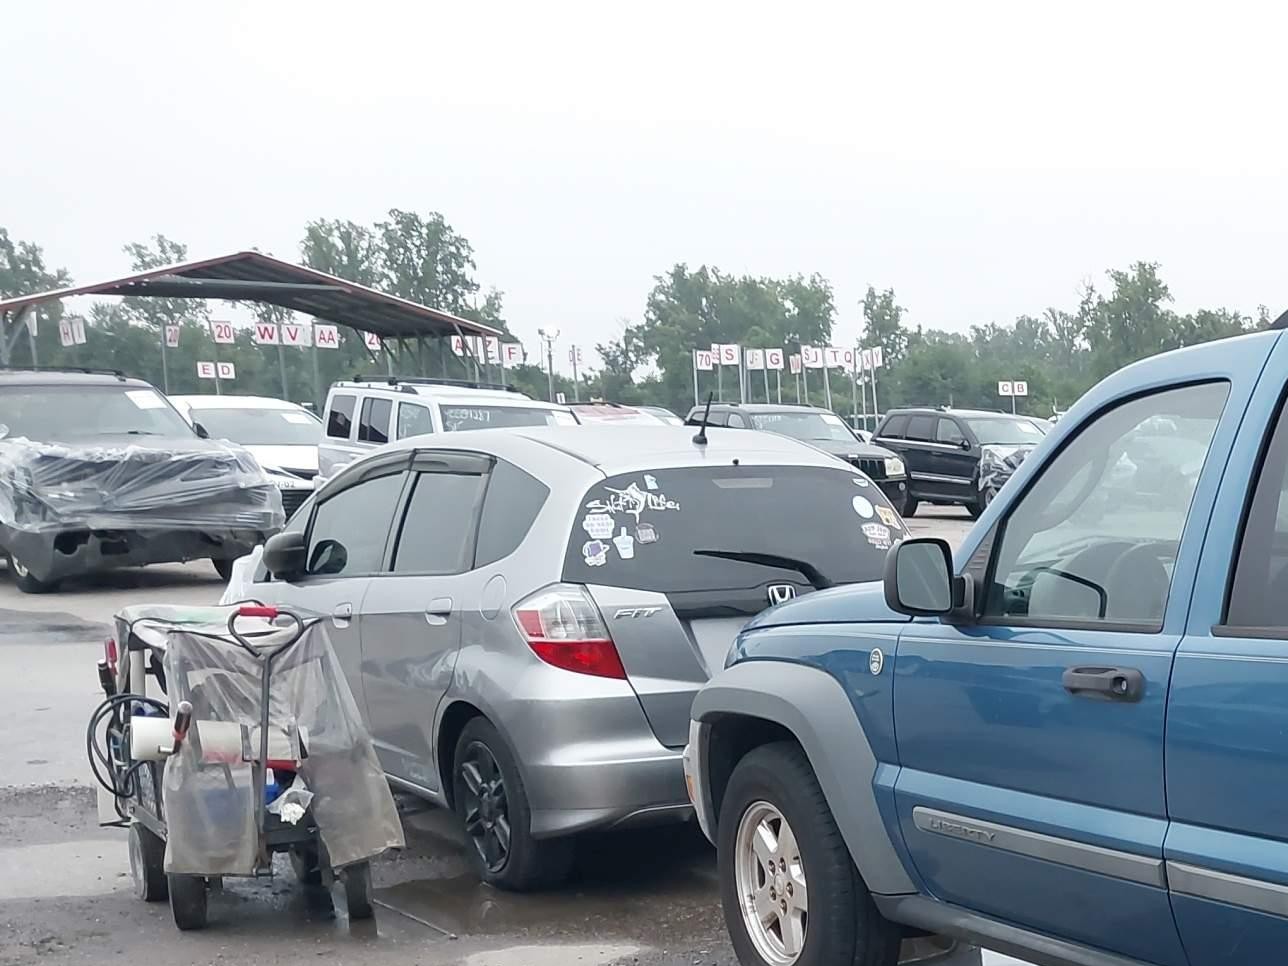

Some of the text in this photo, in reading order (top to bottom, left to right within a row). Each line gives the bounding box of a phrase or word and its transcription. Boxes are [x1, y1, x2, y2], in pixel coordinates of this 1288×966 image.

[215, 324, 231, 338] 20
[257, 326, 275, 340] W
[286, 327, 298, 341] V
[318, 331, 335, 344] AA
[508, 347, 516, 360] F
[698, 353, 711, 366] 70
[725, 348, 734, 360] S
[769, 352, 780, 365] G
[830, 350, 839, 362] T
[844, 351, 852, 363] Q
[202, 365, 211, 375] E
[221, 365, 230, 376] D
[1001, 383, 1009, 393] C
[1017, 383, 1025, 393] B
[613, 607, 664, 620] FIT
[928, 817, 996, 842] LIBERTY
